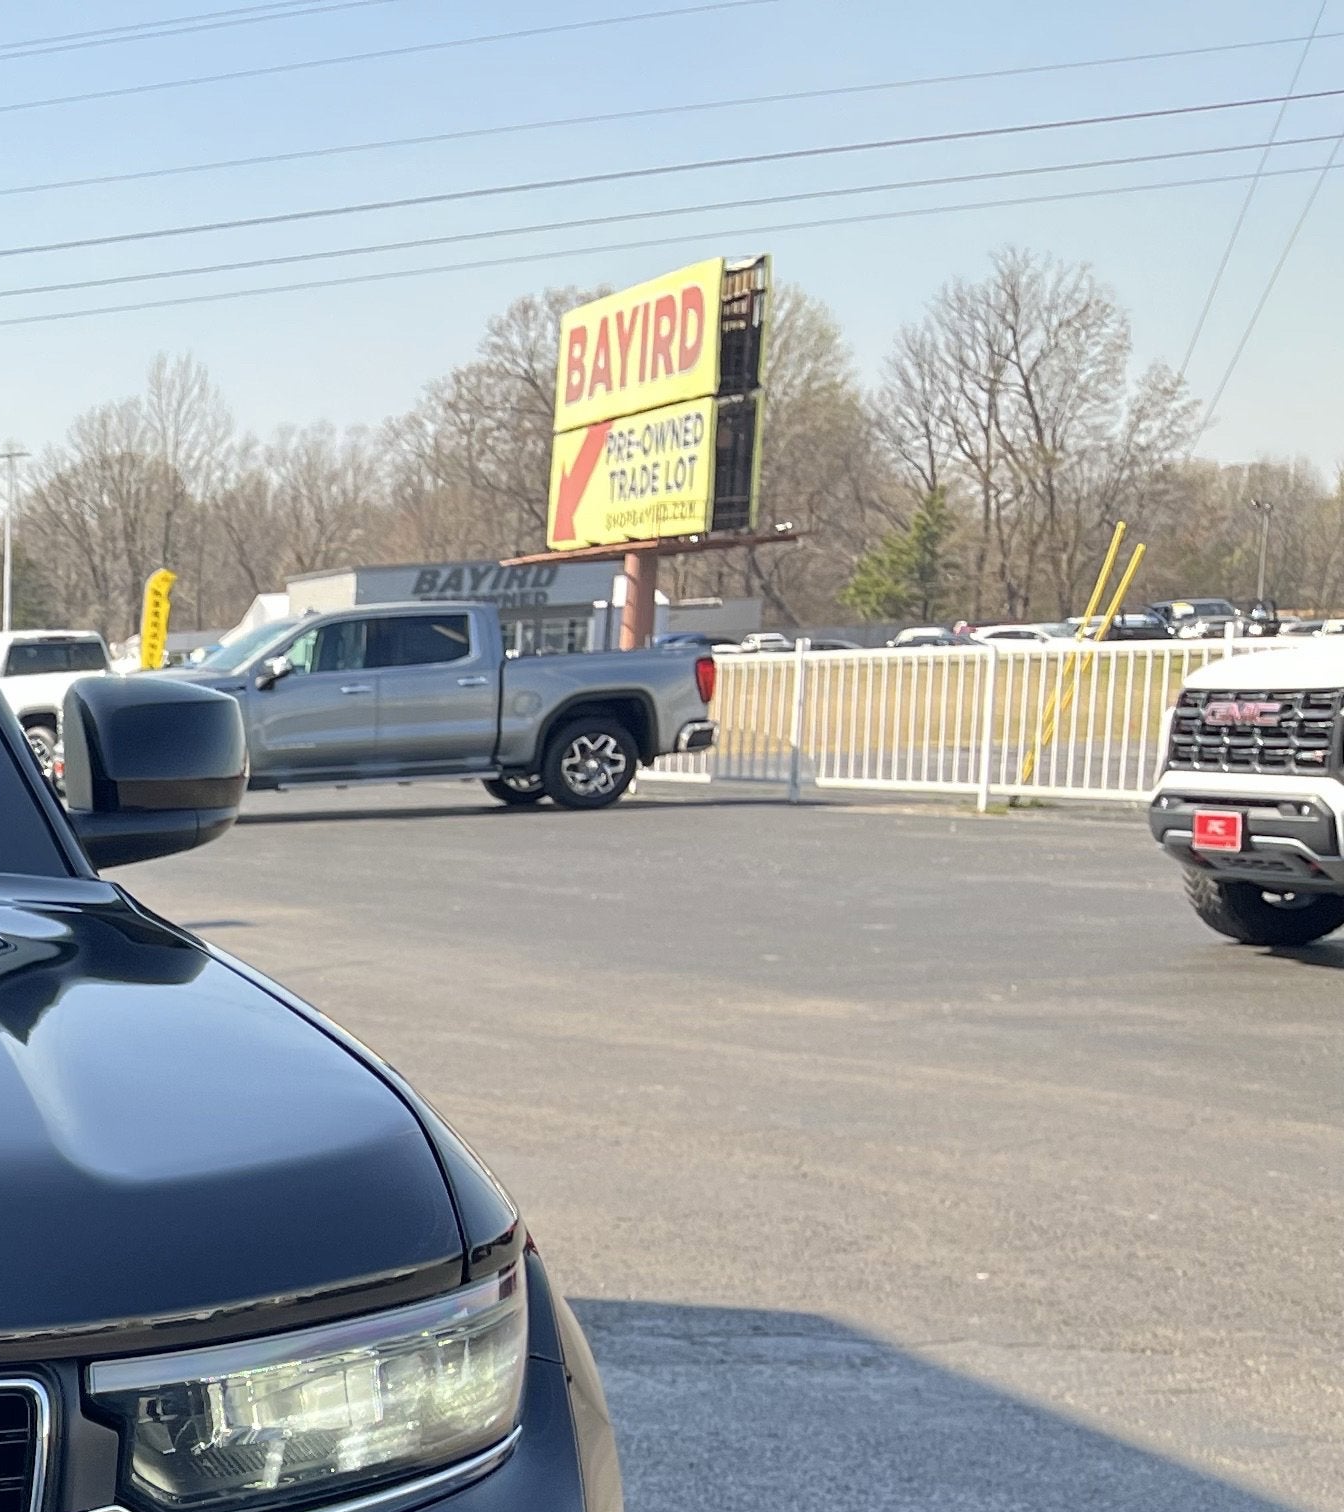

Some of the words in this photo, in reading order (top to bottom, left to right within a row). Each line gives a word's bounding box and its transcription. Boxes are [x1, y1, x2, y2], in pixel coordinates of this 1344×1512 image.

[565, 286, 705, 405] BAYIRD
[605, 411, 703, 465] PRE-OWNED
[609, 464, 659, 504] TRADE
[665, 456, 697, 492] LOT
[412, 566, 559, 594] BAYIRD
[1204, 701, 1282, 726] GMC
